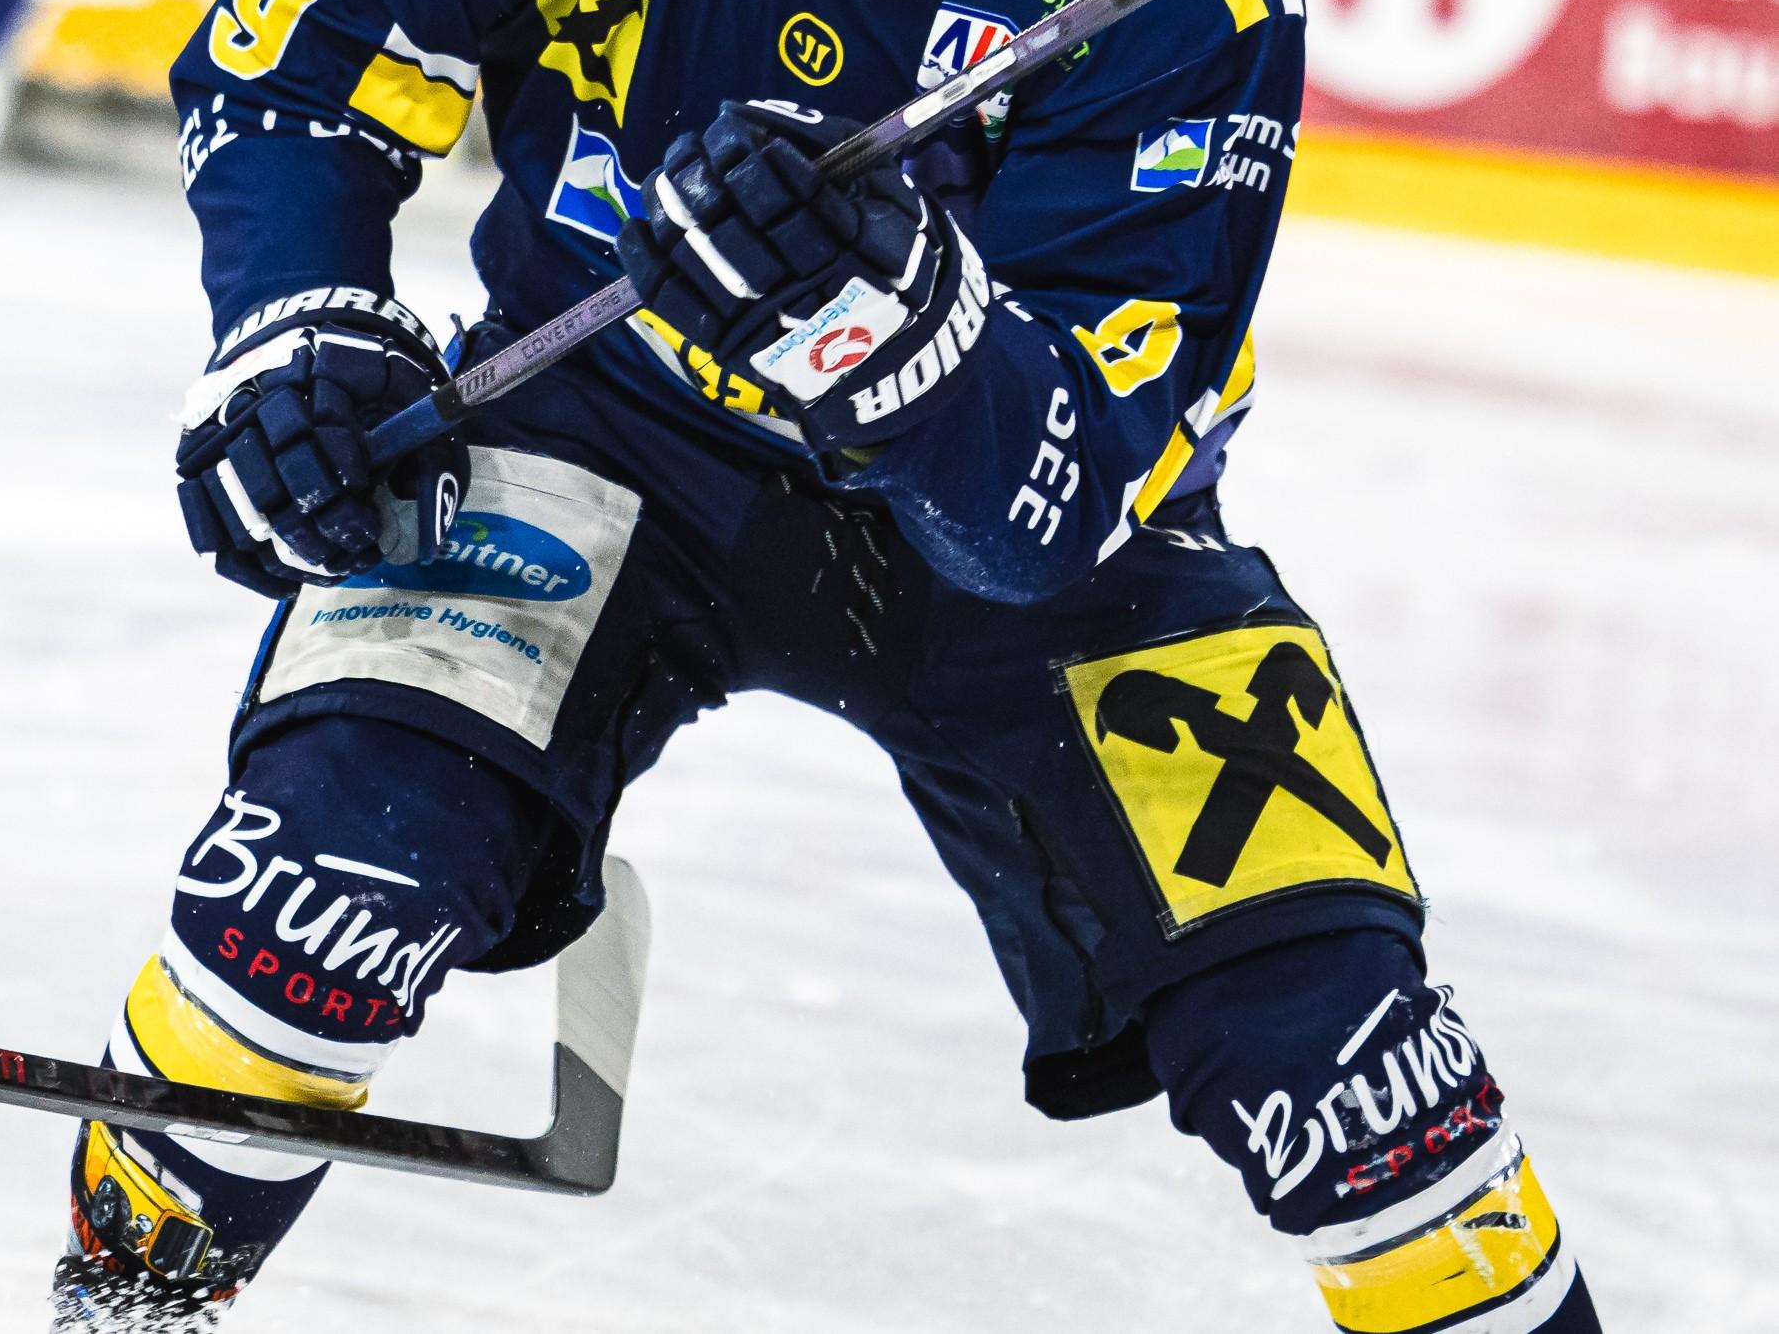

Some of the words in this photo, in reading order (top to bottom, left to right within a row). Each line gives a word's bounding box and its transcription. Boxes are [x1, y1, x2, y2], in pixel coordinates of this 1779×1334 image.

[521, 311, 586, 360] COVERT
[436, 538, 570, 595] eitner
[310, 602, 434, 627] Innovative
[437, 608, 544, 665] Hygiene.
